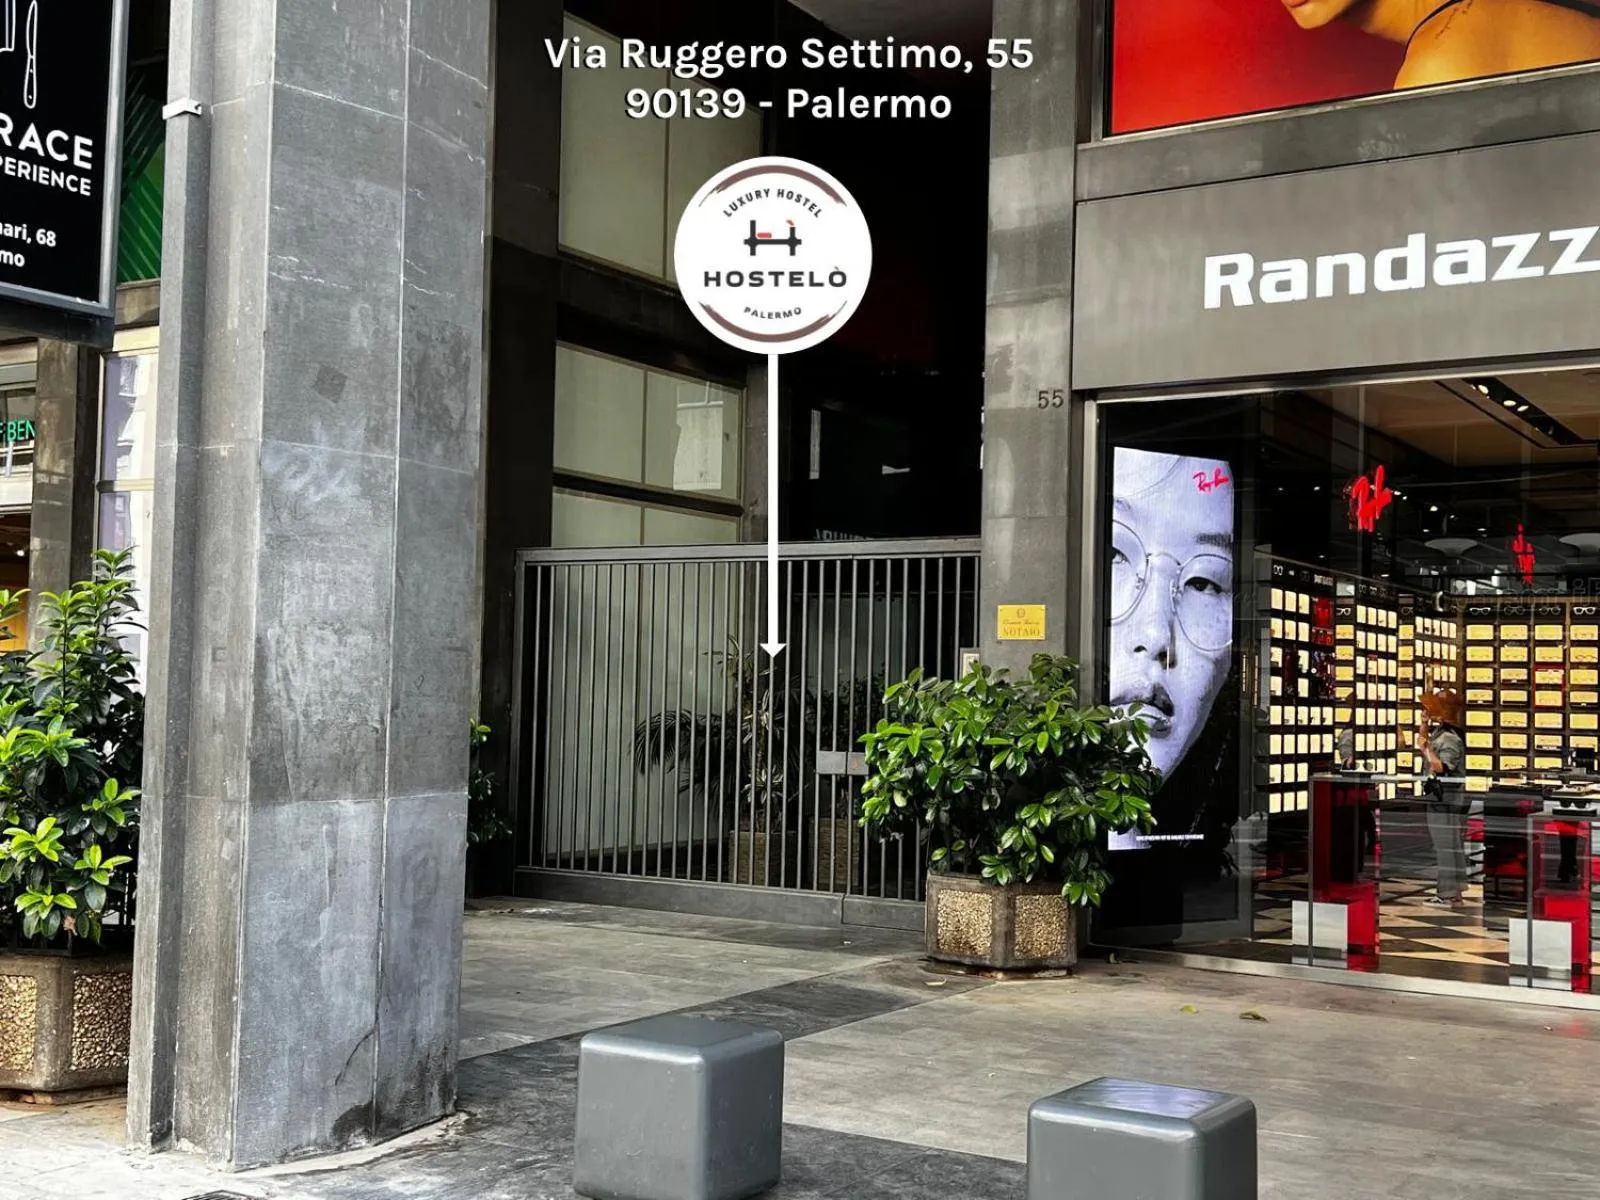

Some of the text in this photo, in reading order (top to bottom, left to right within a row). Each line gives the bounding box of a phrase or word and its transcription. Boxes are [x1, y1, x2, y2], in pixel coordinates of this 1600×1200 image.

[0, 155, 92, 196] ERIENCE
[0, 222, 57, 247] ari, 68
[1203, 225, 1600, 309] Randazz
[1038, 389, 1065, 409] 55
